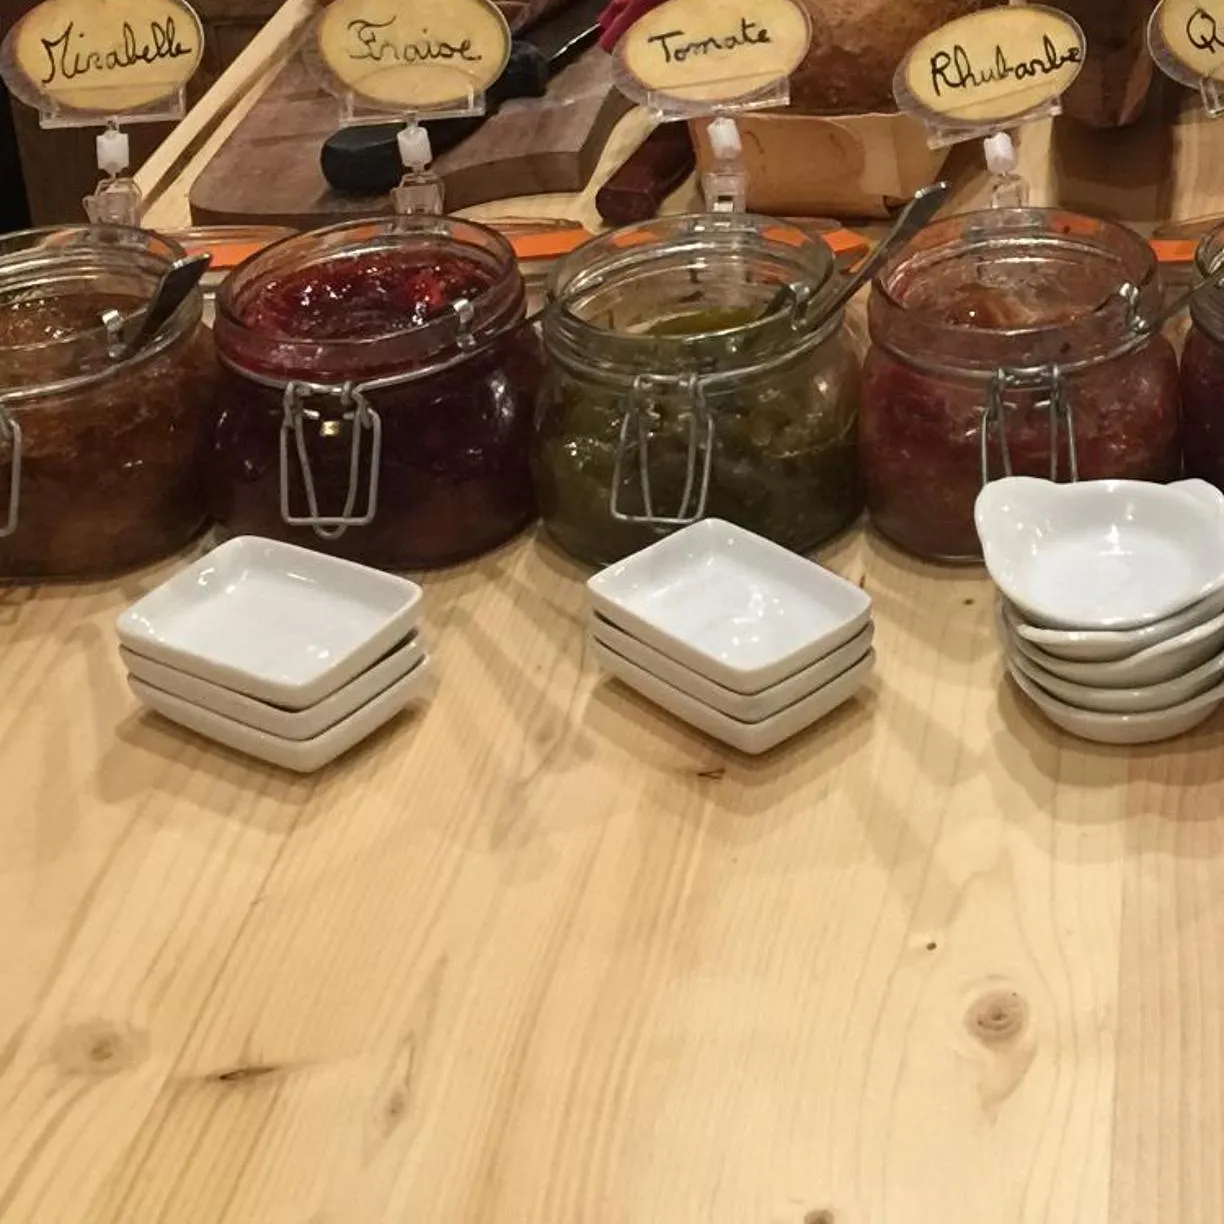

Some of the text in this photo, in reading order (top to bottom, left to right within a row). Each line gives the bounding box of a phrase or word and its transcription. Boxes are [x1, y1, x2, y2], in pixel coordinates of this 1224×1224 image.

[40, 15, 193, 84] Mirabelle
[347, 15, 483, 62] Fraise
[647, 17, 773, 63] Tomate
[929, 33, 1082, 97] Rhubarbe
